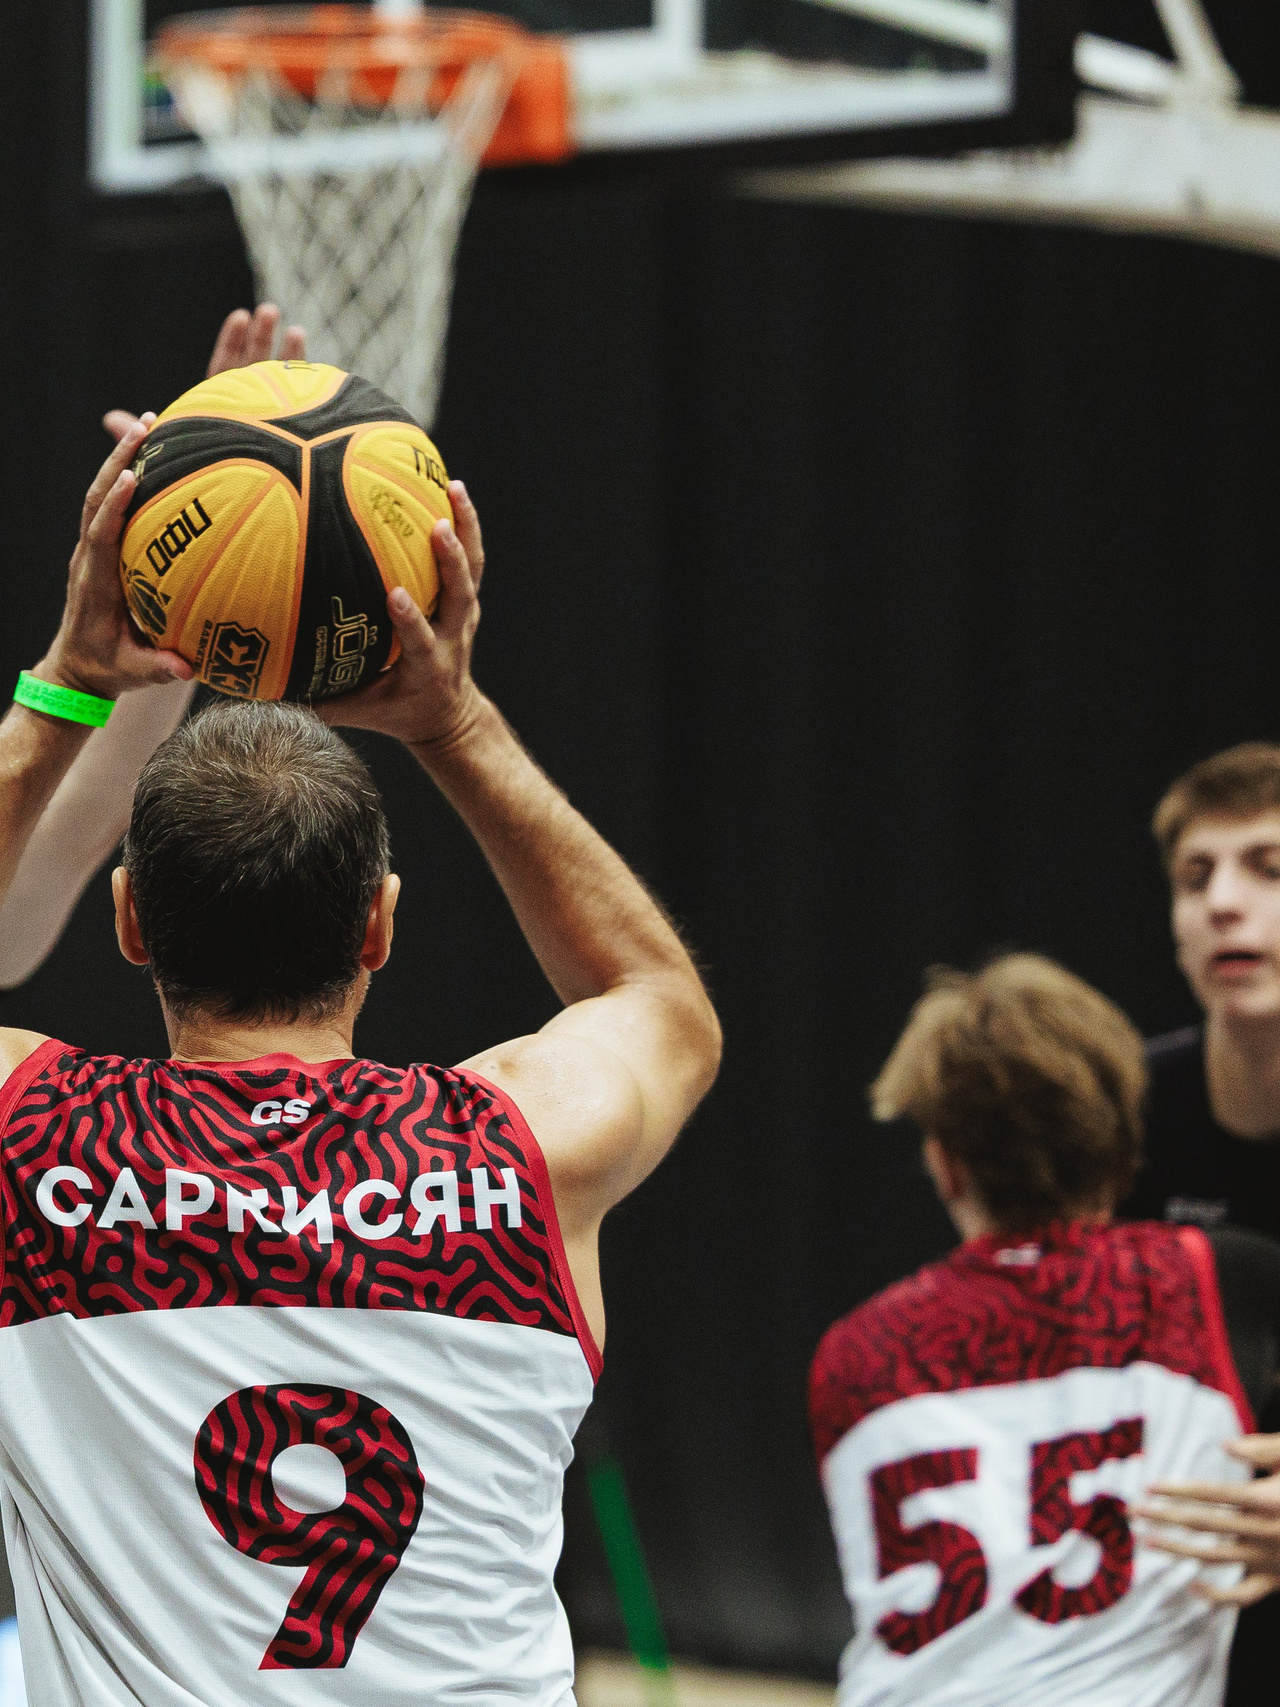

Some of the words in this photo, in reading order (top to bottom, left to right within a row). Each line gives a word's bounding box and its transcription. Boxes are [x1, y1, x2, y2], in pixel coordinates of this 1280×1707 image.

[146, 498, 213, 577] ПФО
[250, 1098, 311, 1126] GS
[35, 1164, 523, 1245] САРКИСЯН
[193, 1382, 426, 1672] 9
[869, 1416, 1146, 1659] 55
